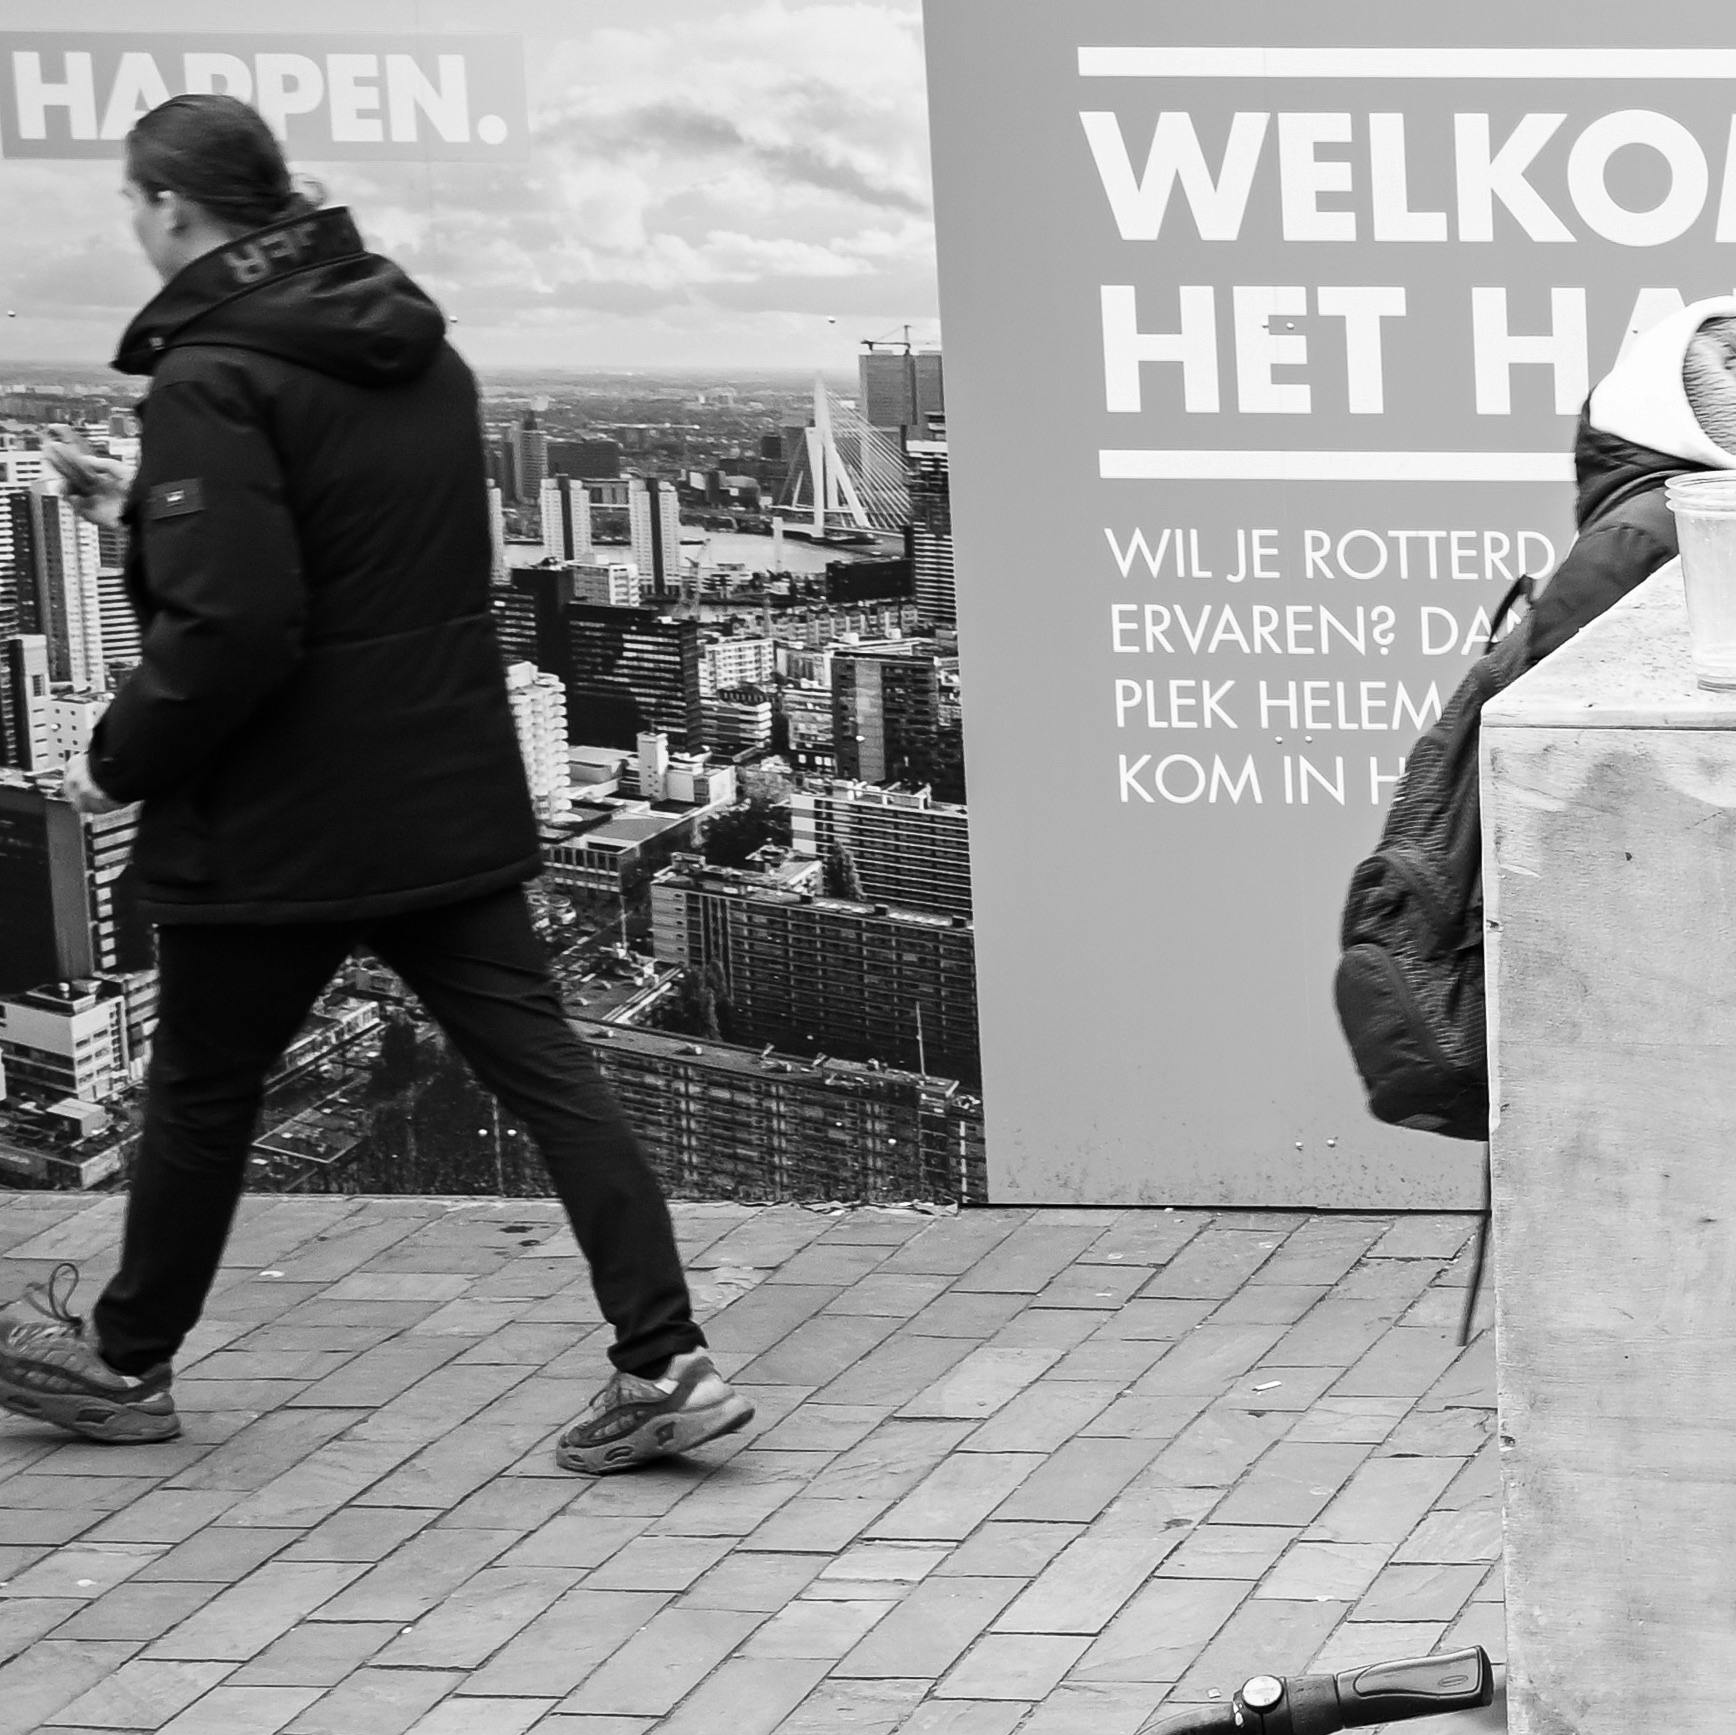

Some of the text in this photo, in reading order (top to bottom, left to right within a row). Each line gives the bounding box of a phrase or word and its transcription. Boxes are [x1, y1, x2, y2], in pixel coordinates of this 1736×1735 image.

[1100, 285, 1407, 415] HET
[1103, 527, 1556, 584] WIL JE ROTTERD
[1111, 603, 1396, 656] ERVAREN?
[1114, 679, 1444, 732] PLEK HELEM
[1117, 754, 1264, 805] KOM
[1284, 755, 1347, 806] IN
